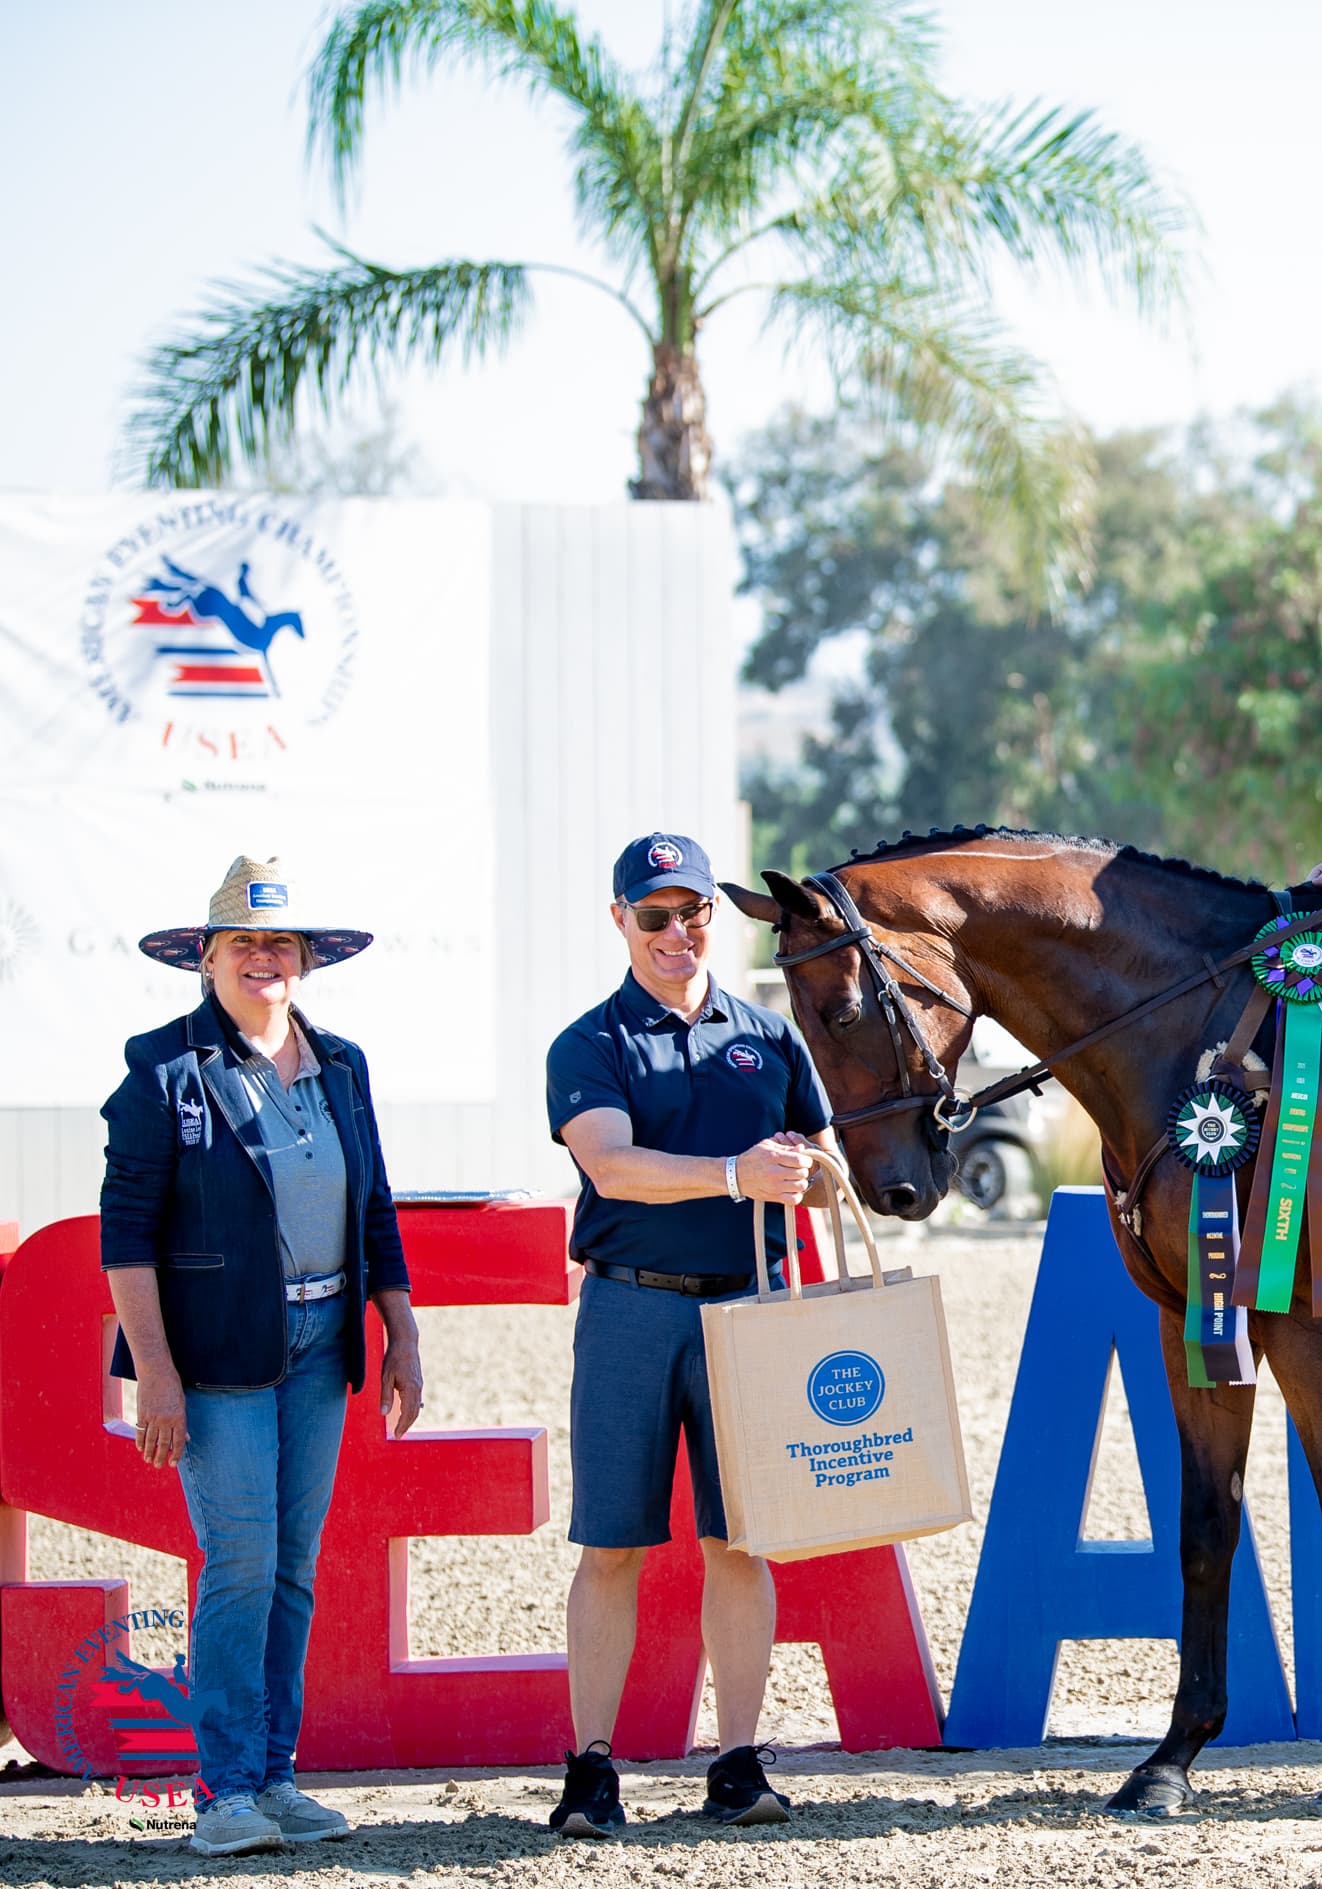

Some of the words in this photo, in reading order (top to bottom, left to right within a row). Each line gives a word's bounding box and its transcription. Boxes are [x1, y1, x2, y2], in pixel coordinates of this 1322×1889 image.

[1275, 1197, 1293, 1241] SIXTH
[1213, 1312, 1224, 1336] POINT
[831, 1367, 861, 1380] THE
[818, 1380, 873, 1397] JOCKEY
[828, 1397, 866, 1410] CLUB
[786, 1427, 914, 1459] Thoroughbred
[809, 1450, 894, 1472] Incentive
[815, 1467, 890, 1487] Program
